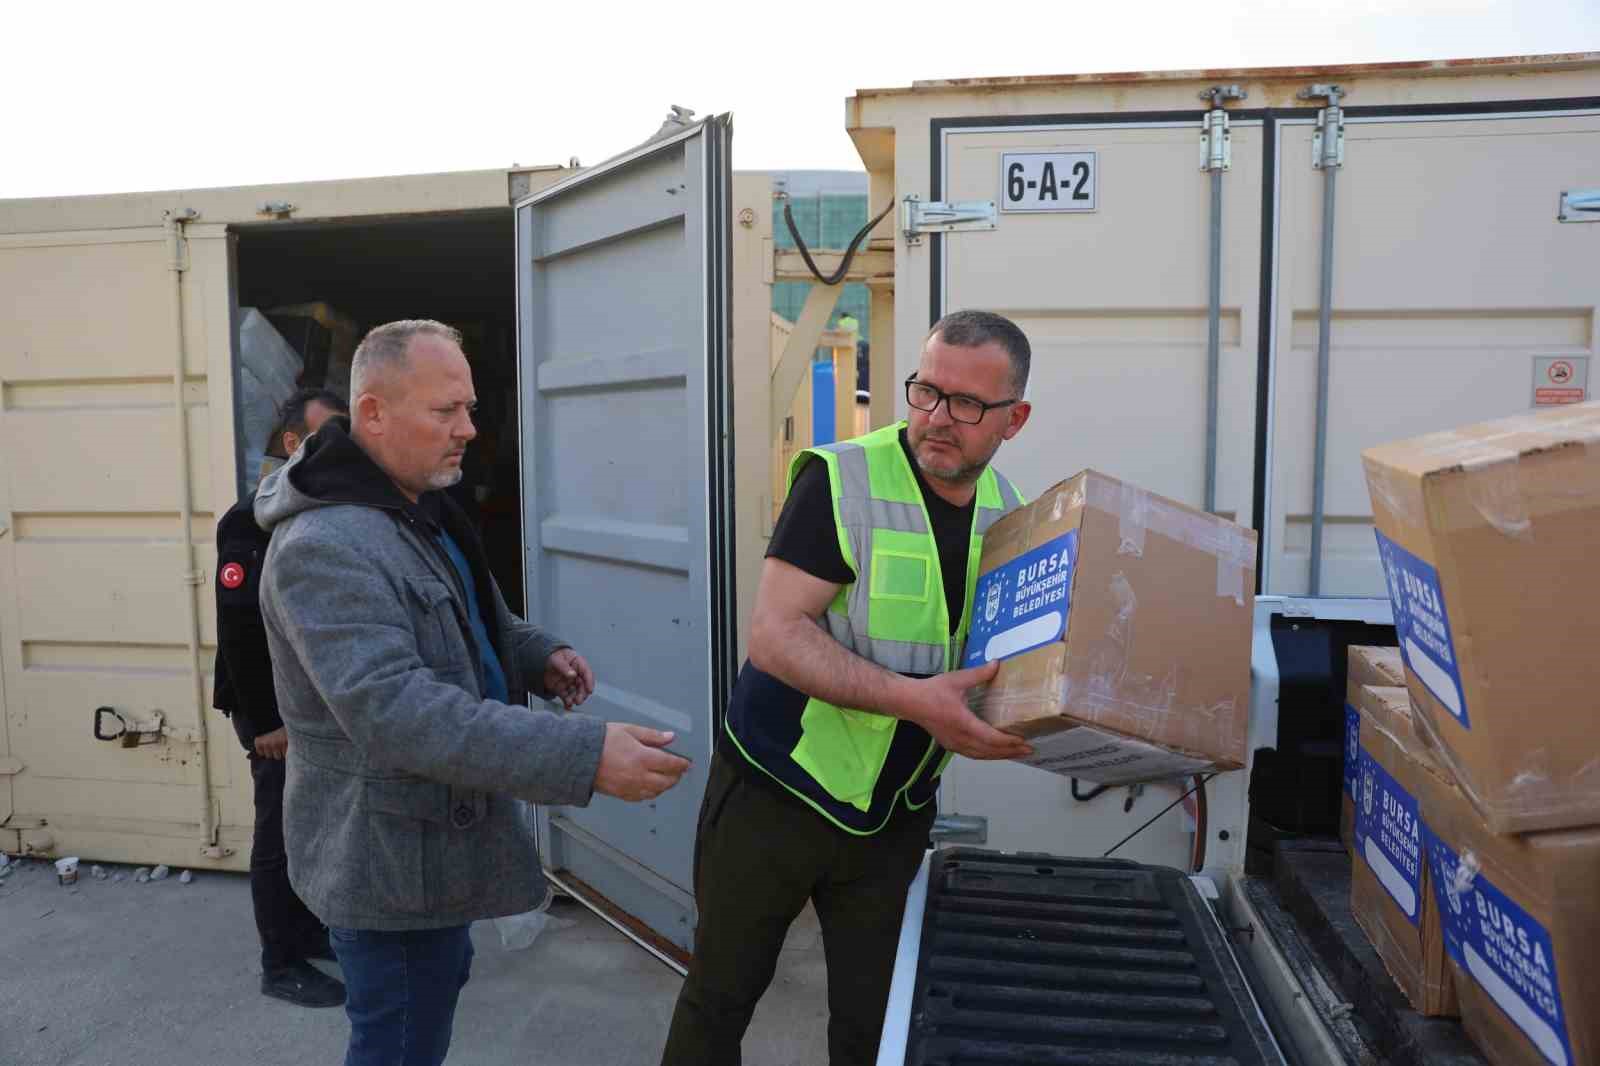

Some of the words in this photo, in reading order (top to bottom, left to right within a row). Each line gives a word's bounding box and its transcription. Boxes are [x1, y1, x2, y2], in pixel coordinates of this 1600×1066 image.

[1008, 161, 1089, 202] 6-A-2
[1015, 569, 1067, 602] BÜYÜKŞEHİR
[1017, 549, 1069, 587] BURSA
[1013, 582, 1066, 618] BELEDİYESİ
[1402, 568, 1442, 618] BURSA
[1383, 790, 1419, 841] BURSA
[1381, 831, 1417, 880] BELEDİYESİ
[1475, 890, 1549, 974] BURSA
